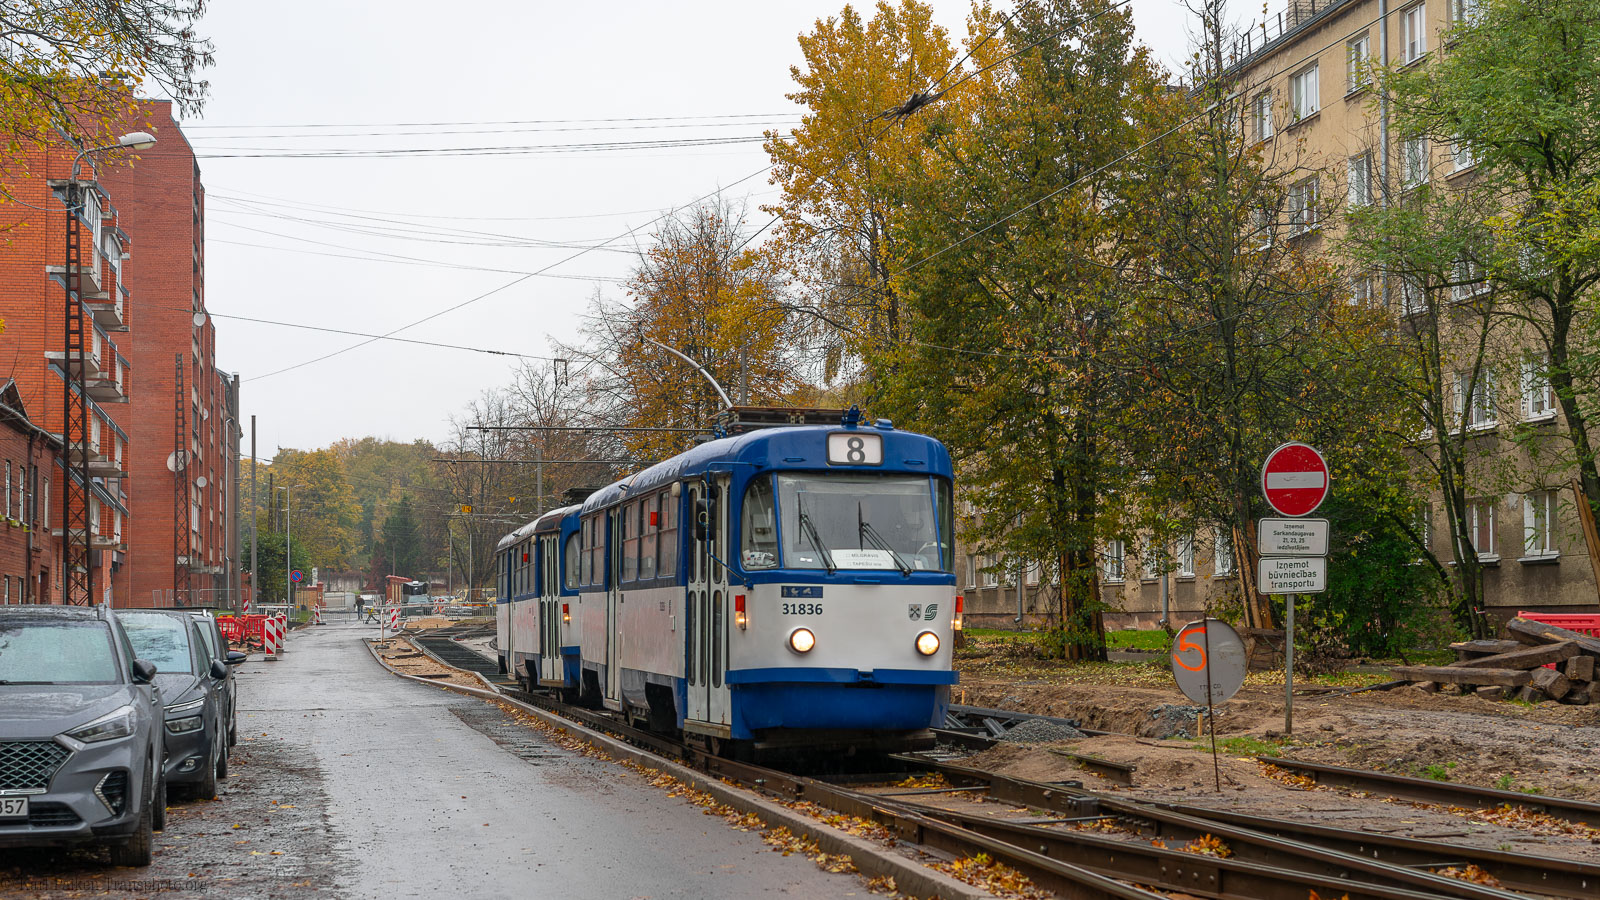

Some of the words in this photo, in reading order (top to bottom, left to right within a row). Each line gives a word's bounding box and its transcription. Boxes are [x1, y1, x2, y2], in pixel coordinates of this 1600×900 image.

[847, 437, 865, 464] 8
[1276, 561, 1309, 571] Izņemot
[1268, 570, 1317, 580] būvniecības
[1271, 580, 1315, 589] transportu
[782, 603, 823, 615] 31836
[1173, 627, 1207, 672] 5
